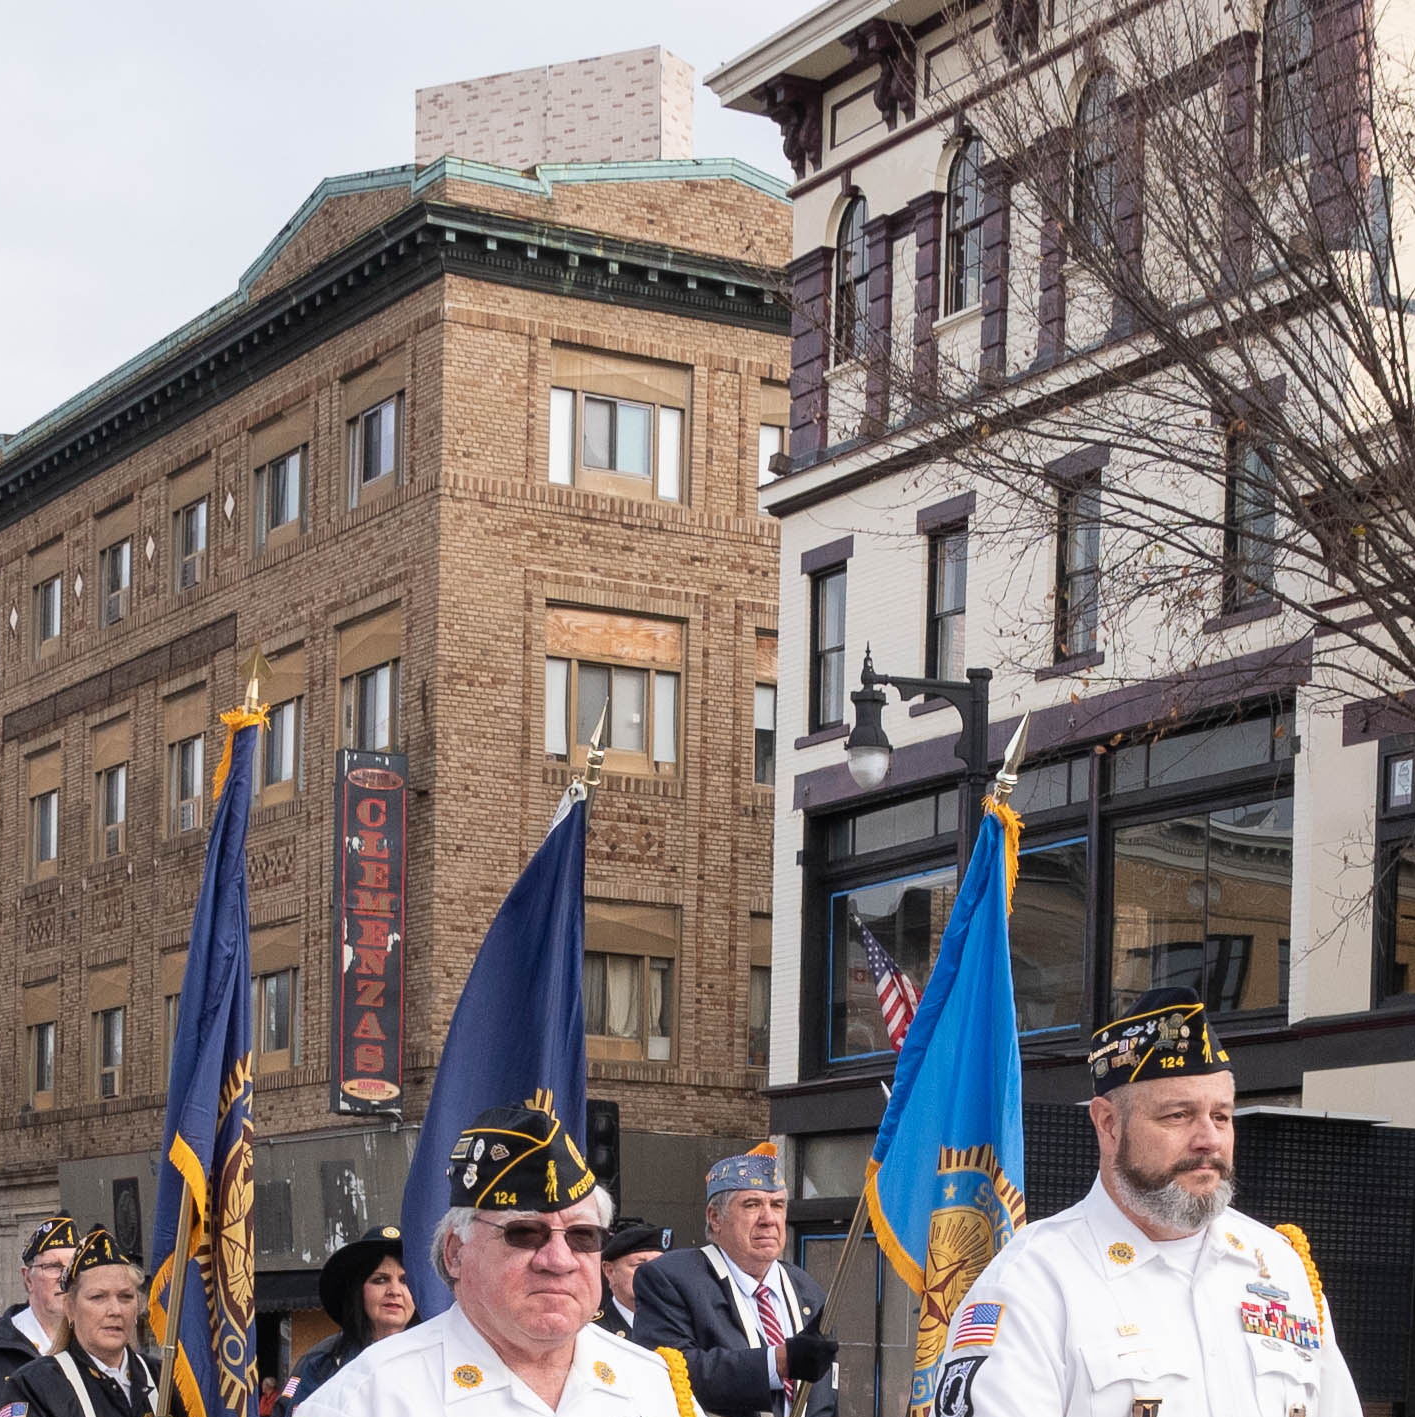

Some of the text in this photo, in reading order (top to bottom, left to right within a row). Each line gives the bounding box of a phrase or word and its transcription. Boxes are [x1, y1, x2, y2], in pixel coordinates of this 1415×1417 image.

[353, 797, 396, 1073] CLEMENZAS
[1160, 1055, 1185, 1068] 124
[494, 1191, 517, 1205] 124
